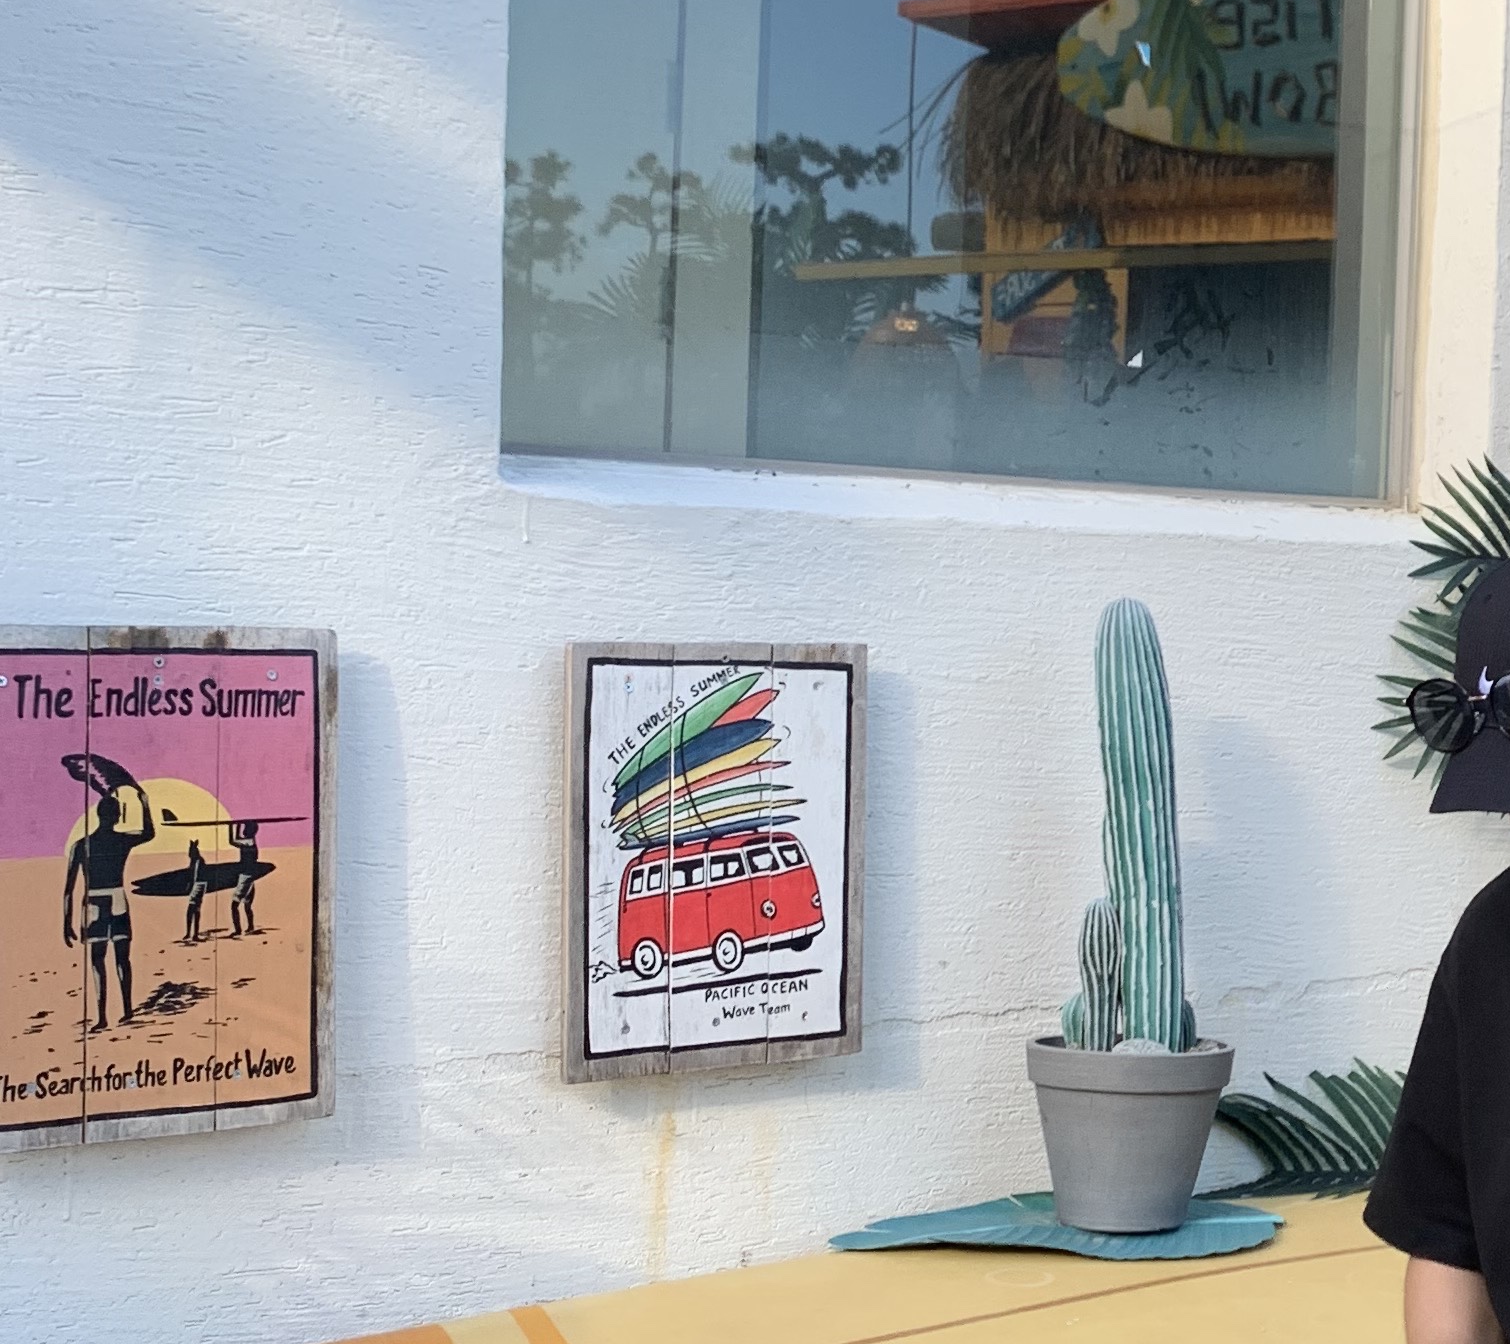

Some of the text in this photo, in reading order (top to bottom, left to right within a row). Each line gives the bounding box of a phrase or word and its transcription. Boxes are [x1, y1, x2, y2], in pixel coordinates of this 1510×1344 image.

[13, 674, 305, 719] The Endless Summer
[607, 665, 741, 765] THE ENDLESS SUMMER
[705, 979, 808, 1002] PACIFIC OCEAN
[722, 1002, 790, 1019] Wave Team
[0, 1048, 297, 1102] he Search for the Perfect Wave
